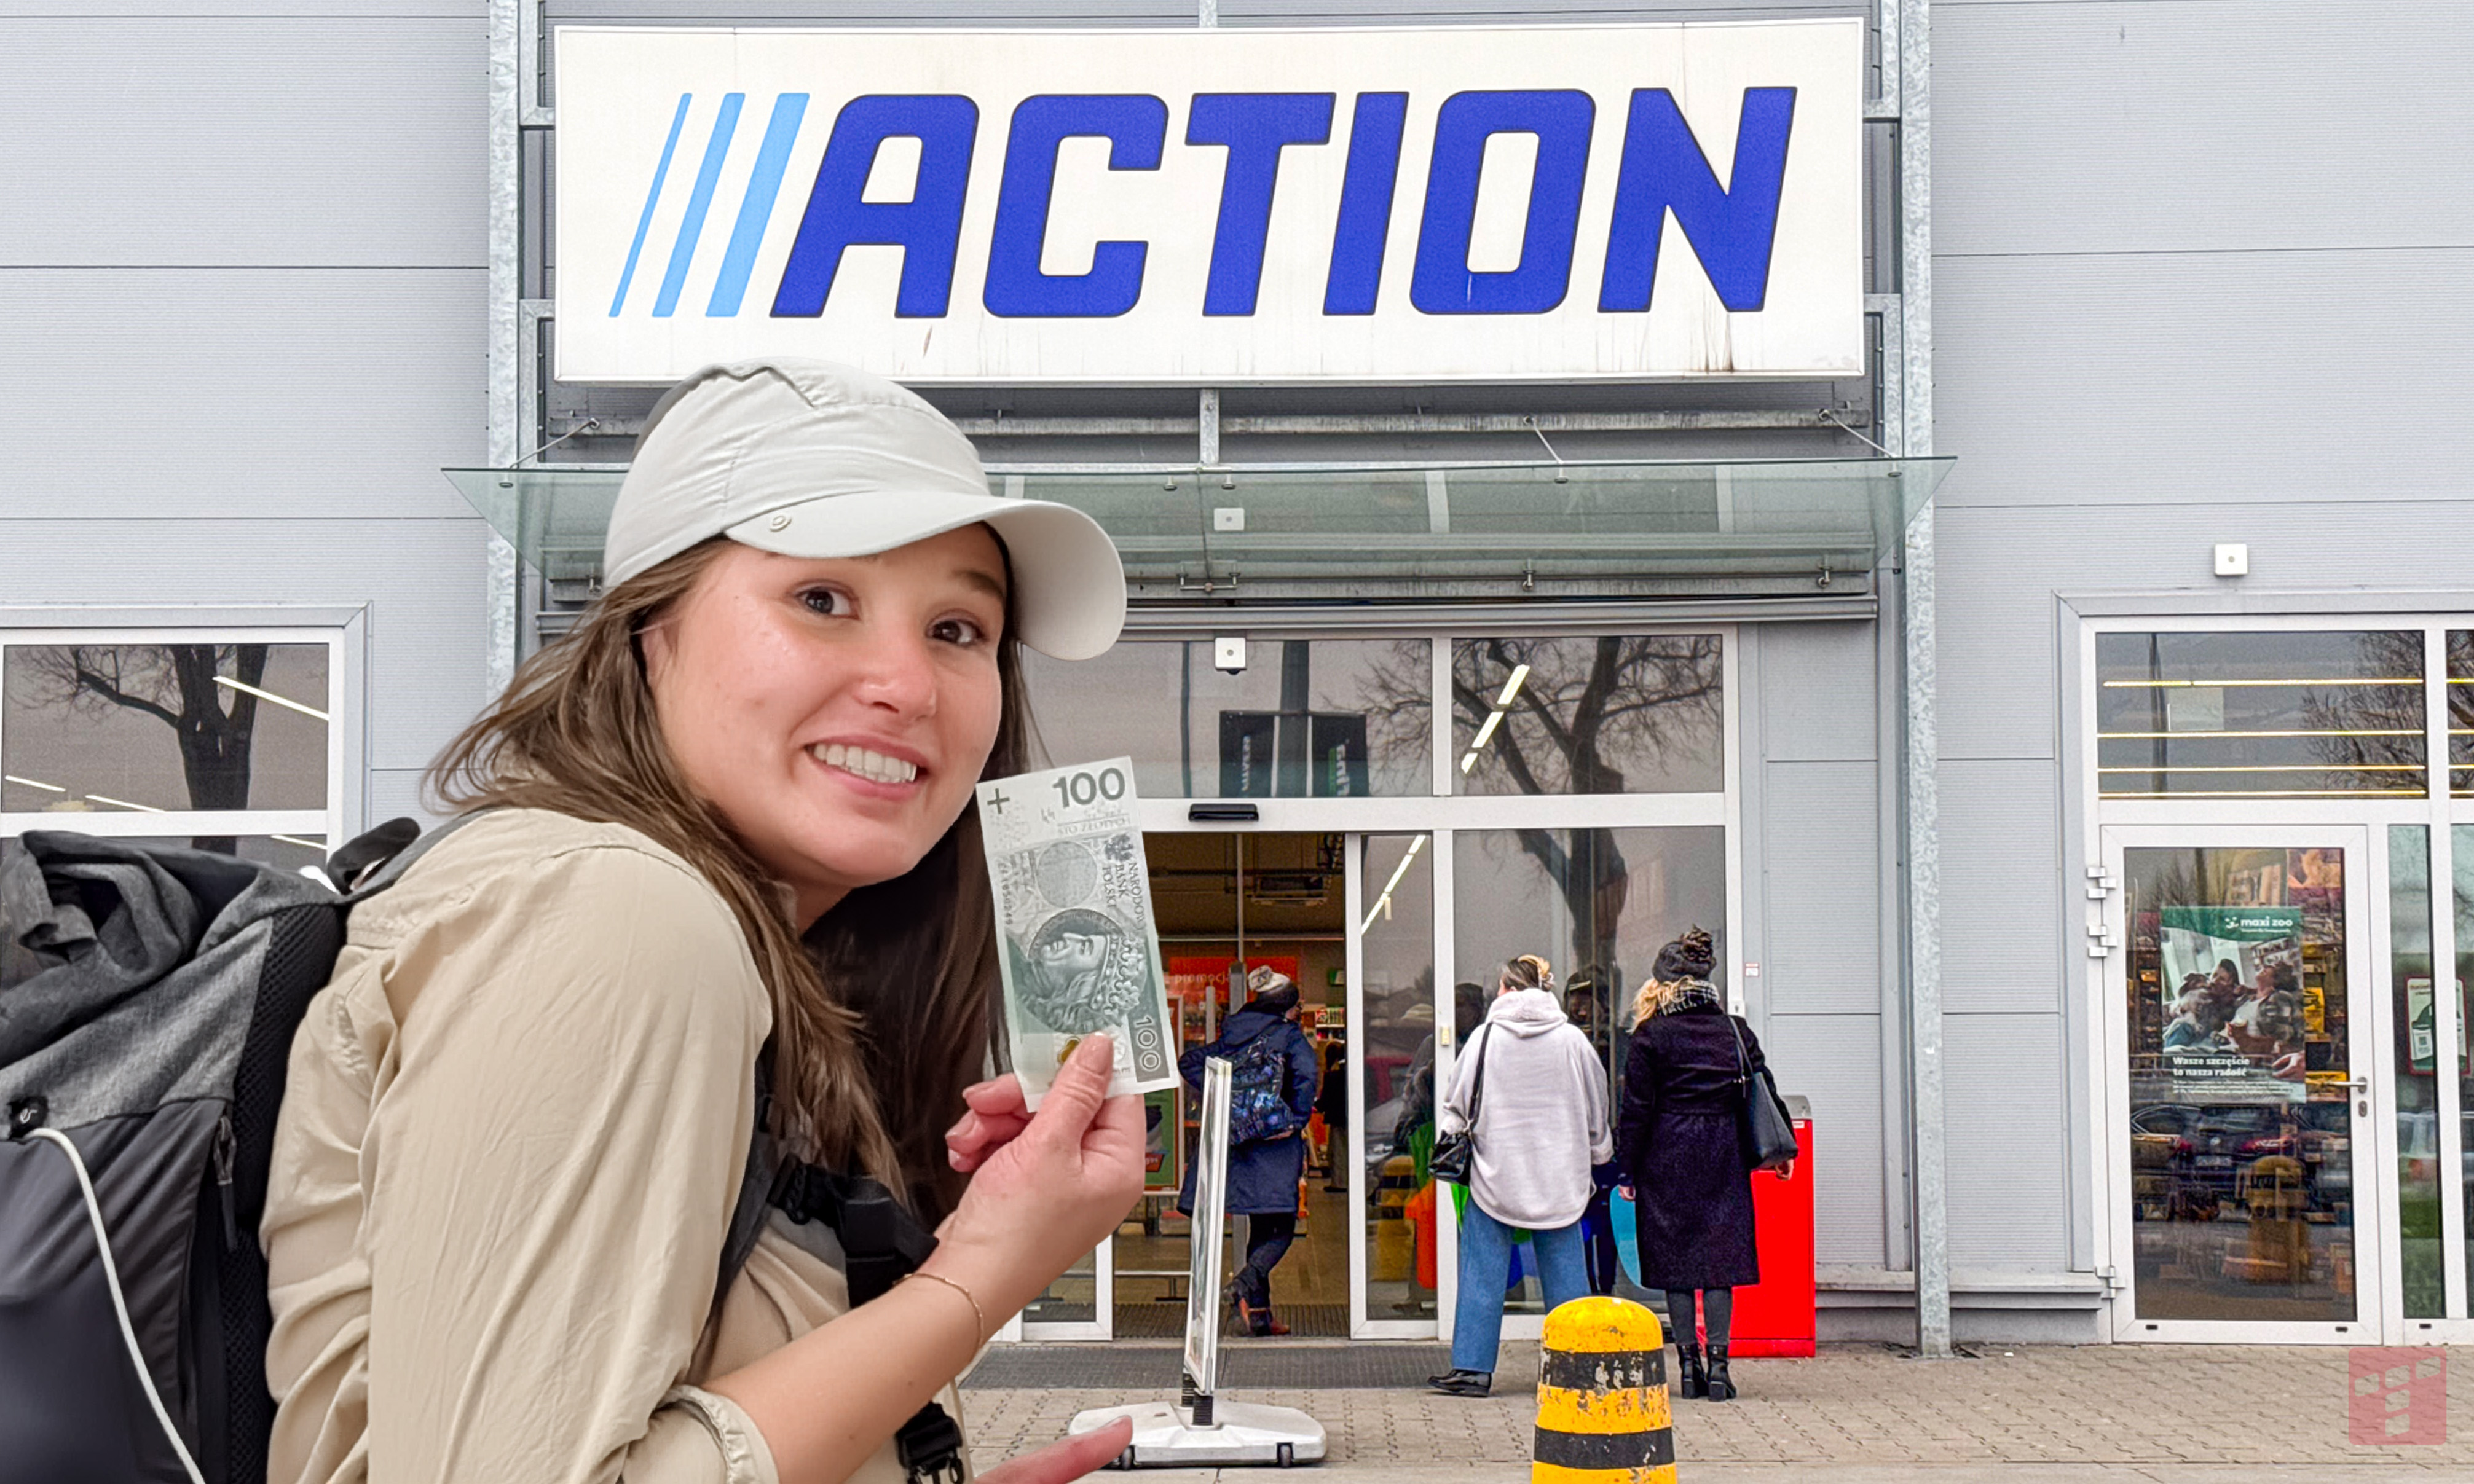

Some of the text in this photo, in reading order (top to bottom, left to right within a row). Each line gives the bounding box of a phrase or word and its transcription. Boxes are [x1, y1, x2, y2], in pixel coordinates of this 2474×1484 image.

[770, 87, 1796, 318] ACTION
[1052, 768, 1125, 808] 100
[1116, 864, 1129, 898] BANK
[2240, 915, 2269, 927] maxi
[1134, 1015, 1160, 1071] 100
[2173, 1056, 2250, 1067] Wasze szczęście
[2215, 1067, 2247, 1076] radość
